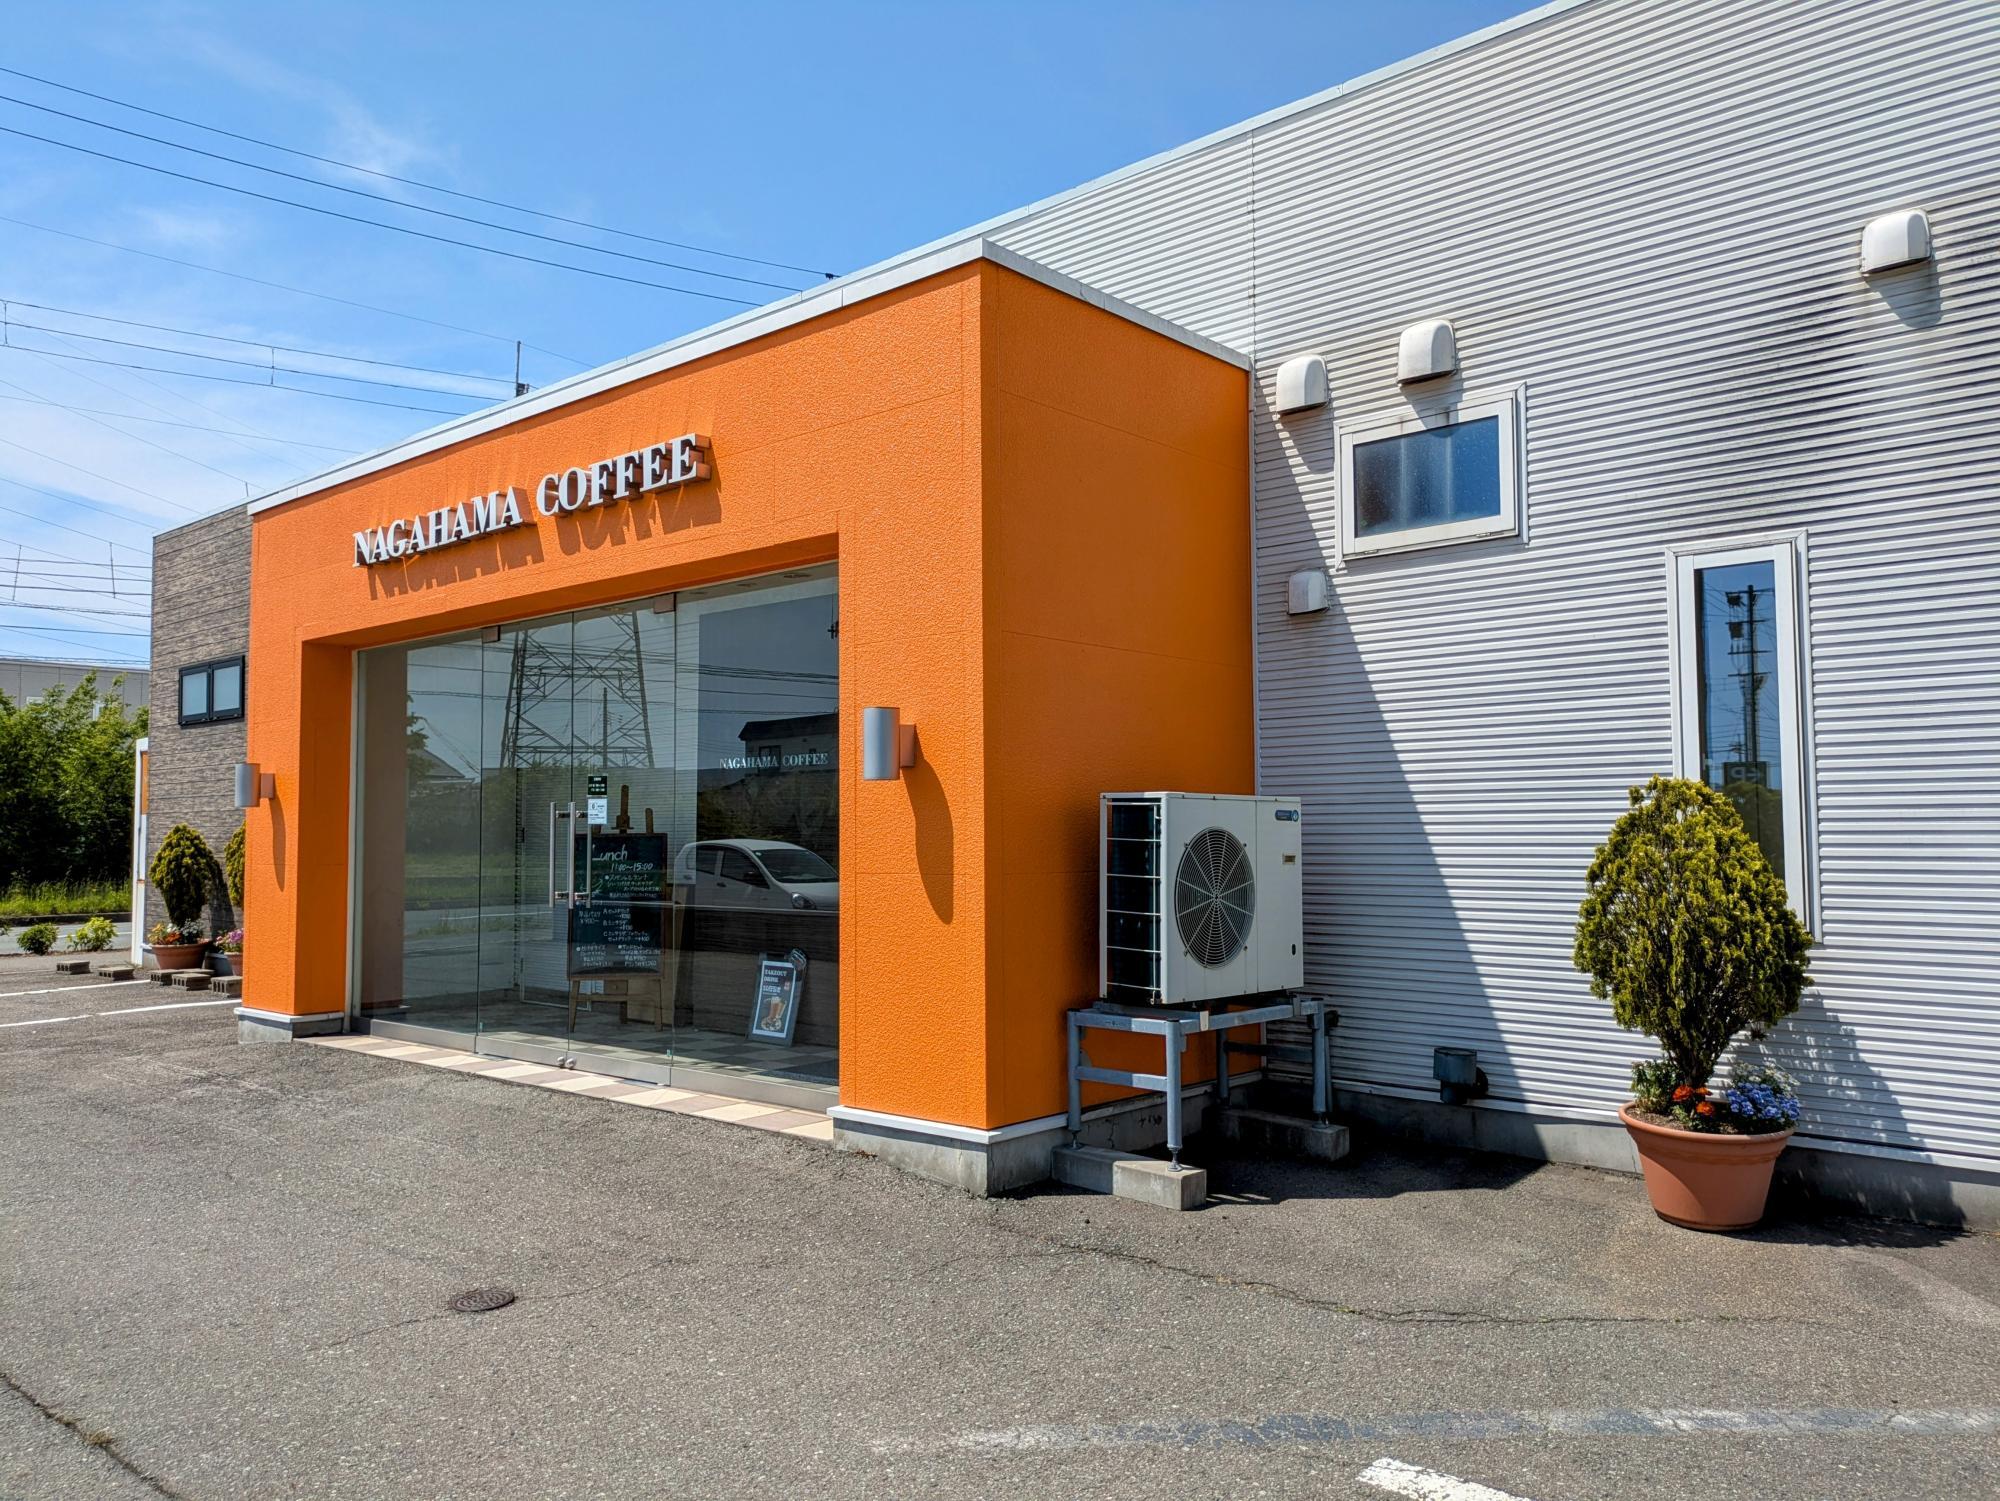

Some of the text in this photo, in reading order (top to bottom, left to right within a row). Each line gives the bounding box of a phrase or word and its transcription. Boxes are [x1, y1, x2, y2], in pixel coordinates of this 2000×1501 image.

[353, 433, 698, 567] NAGAHAMA COFFEE
[719, 752, 829, 769] NAGAHAMA COFFEE
